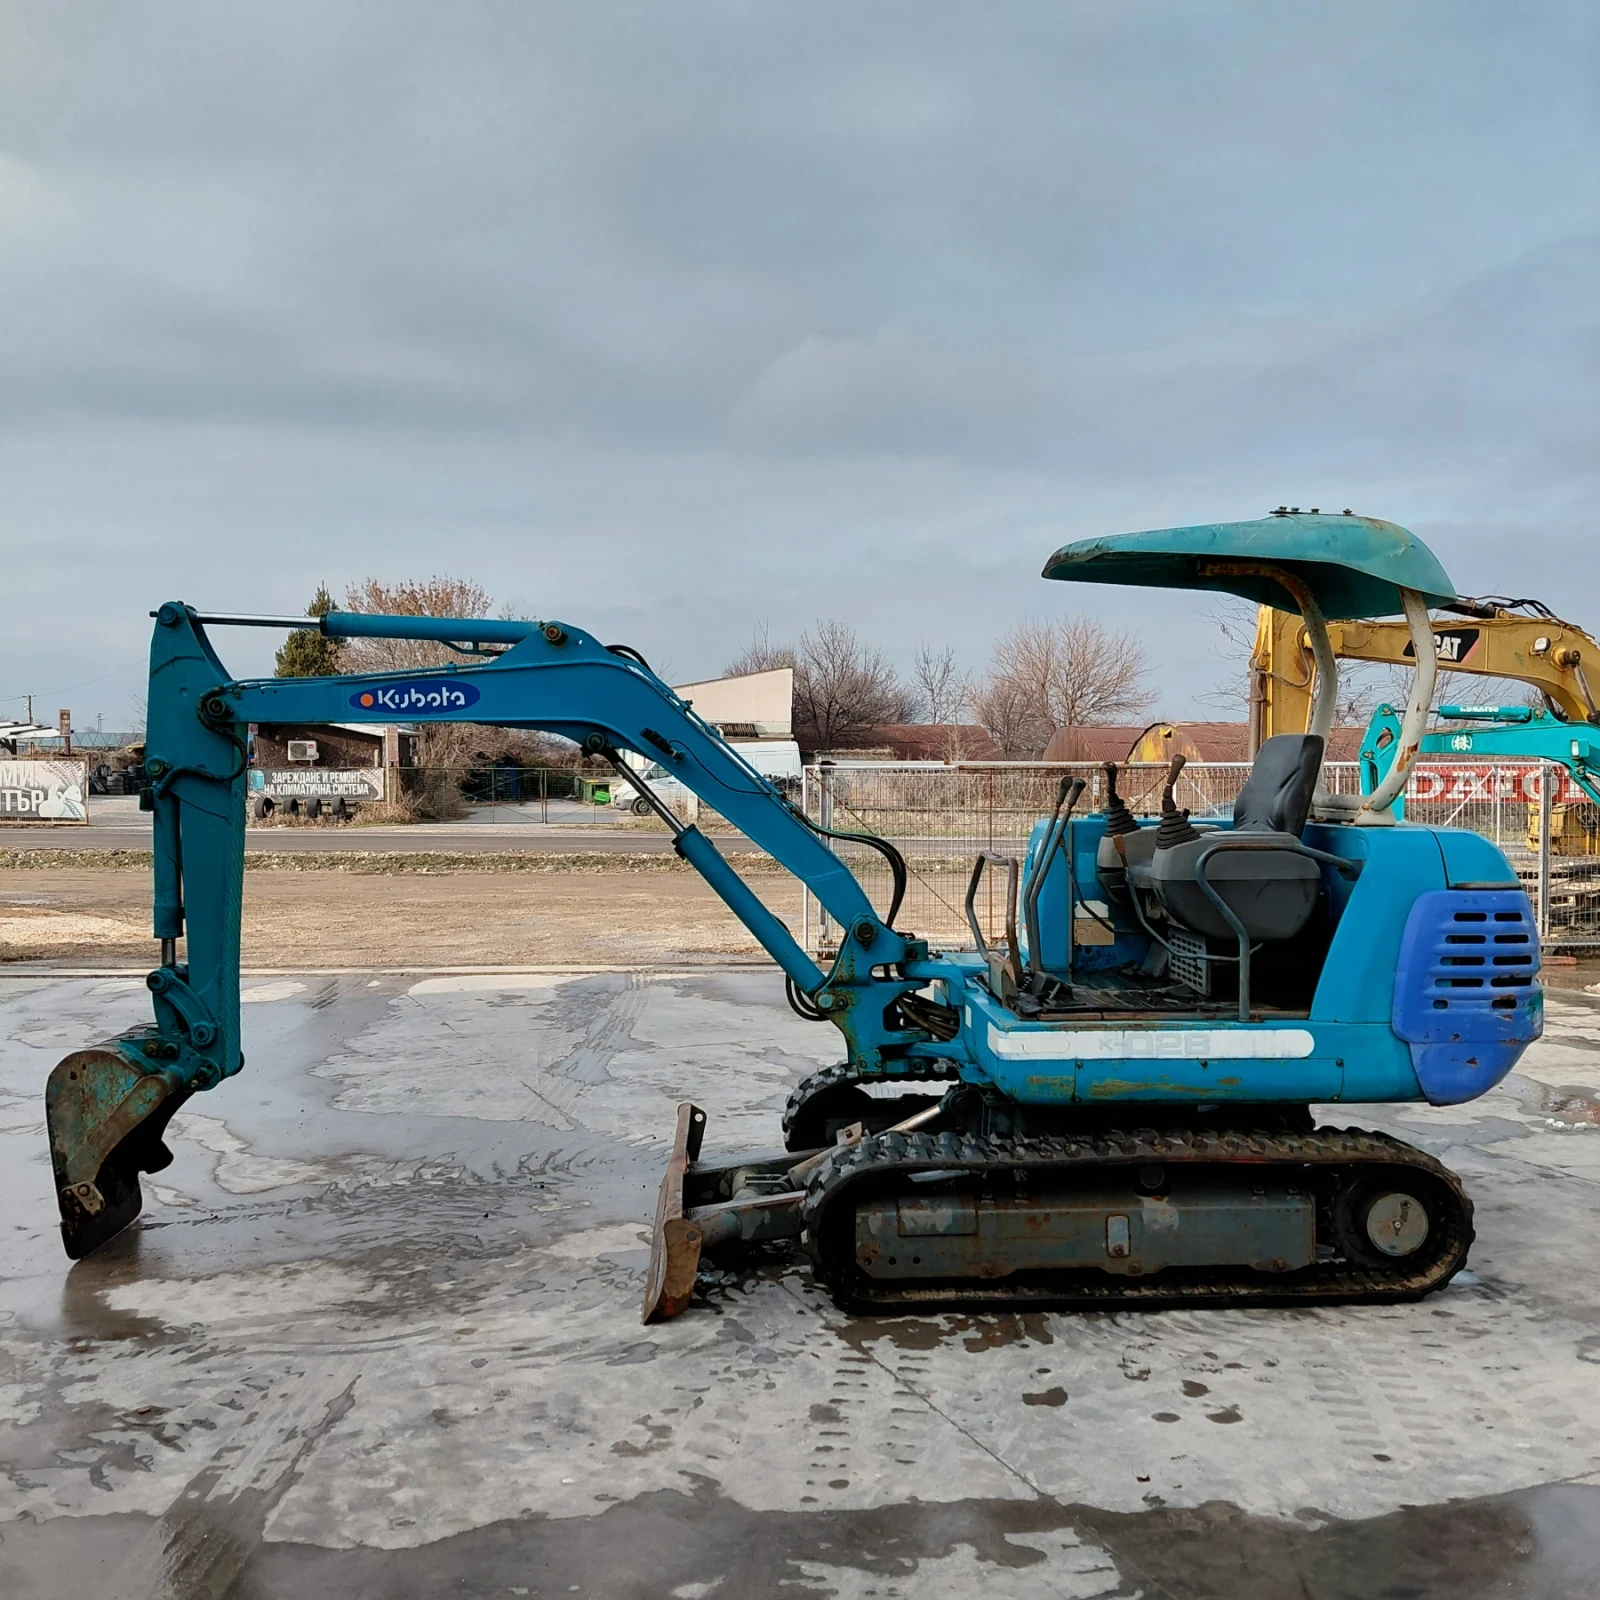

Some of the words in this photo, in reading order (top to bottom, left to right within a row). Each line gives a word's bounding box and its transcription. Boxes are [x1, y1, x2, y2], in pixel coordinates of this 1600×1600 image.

[1434, 634, 1461, 660] CAT
[377, 686, 466, 709] Kubota
[271, 771, 321, 784] ЗАРЕЖДАНЕ
[322, 772, 329, 783] И
[330, 771, 361, 783] РЕМОНТ
[264, 785, 276, 795] НА
[277, 784, 331, 795] КЛИМАТИЧНА
[332, 783, 369, 795] СИСТЕМА
